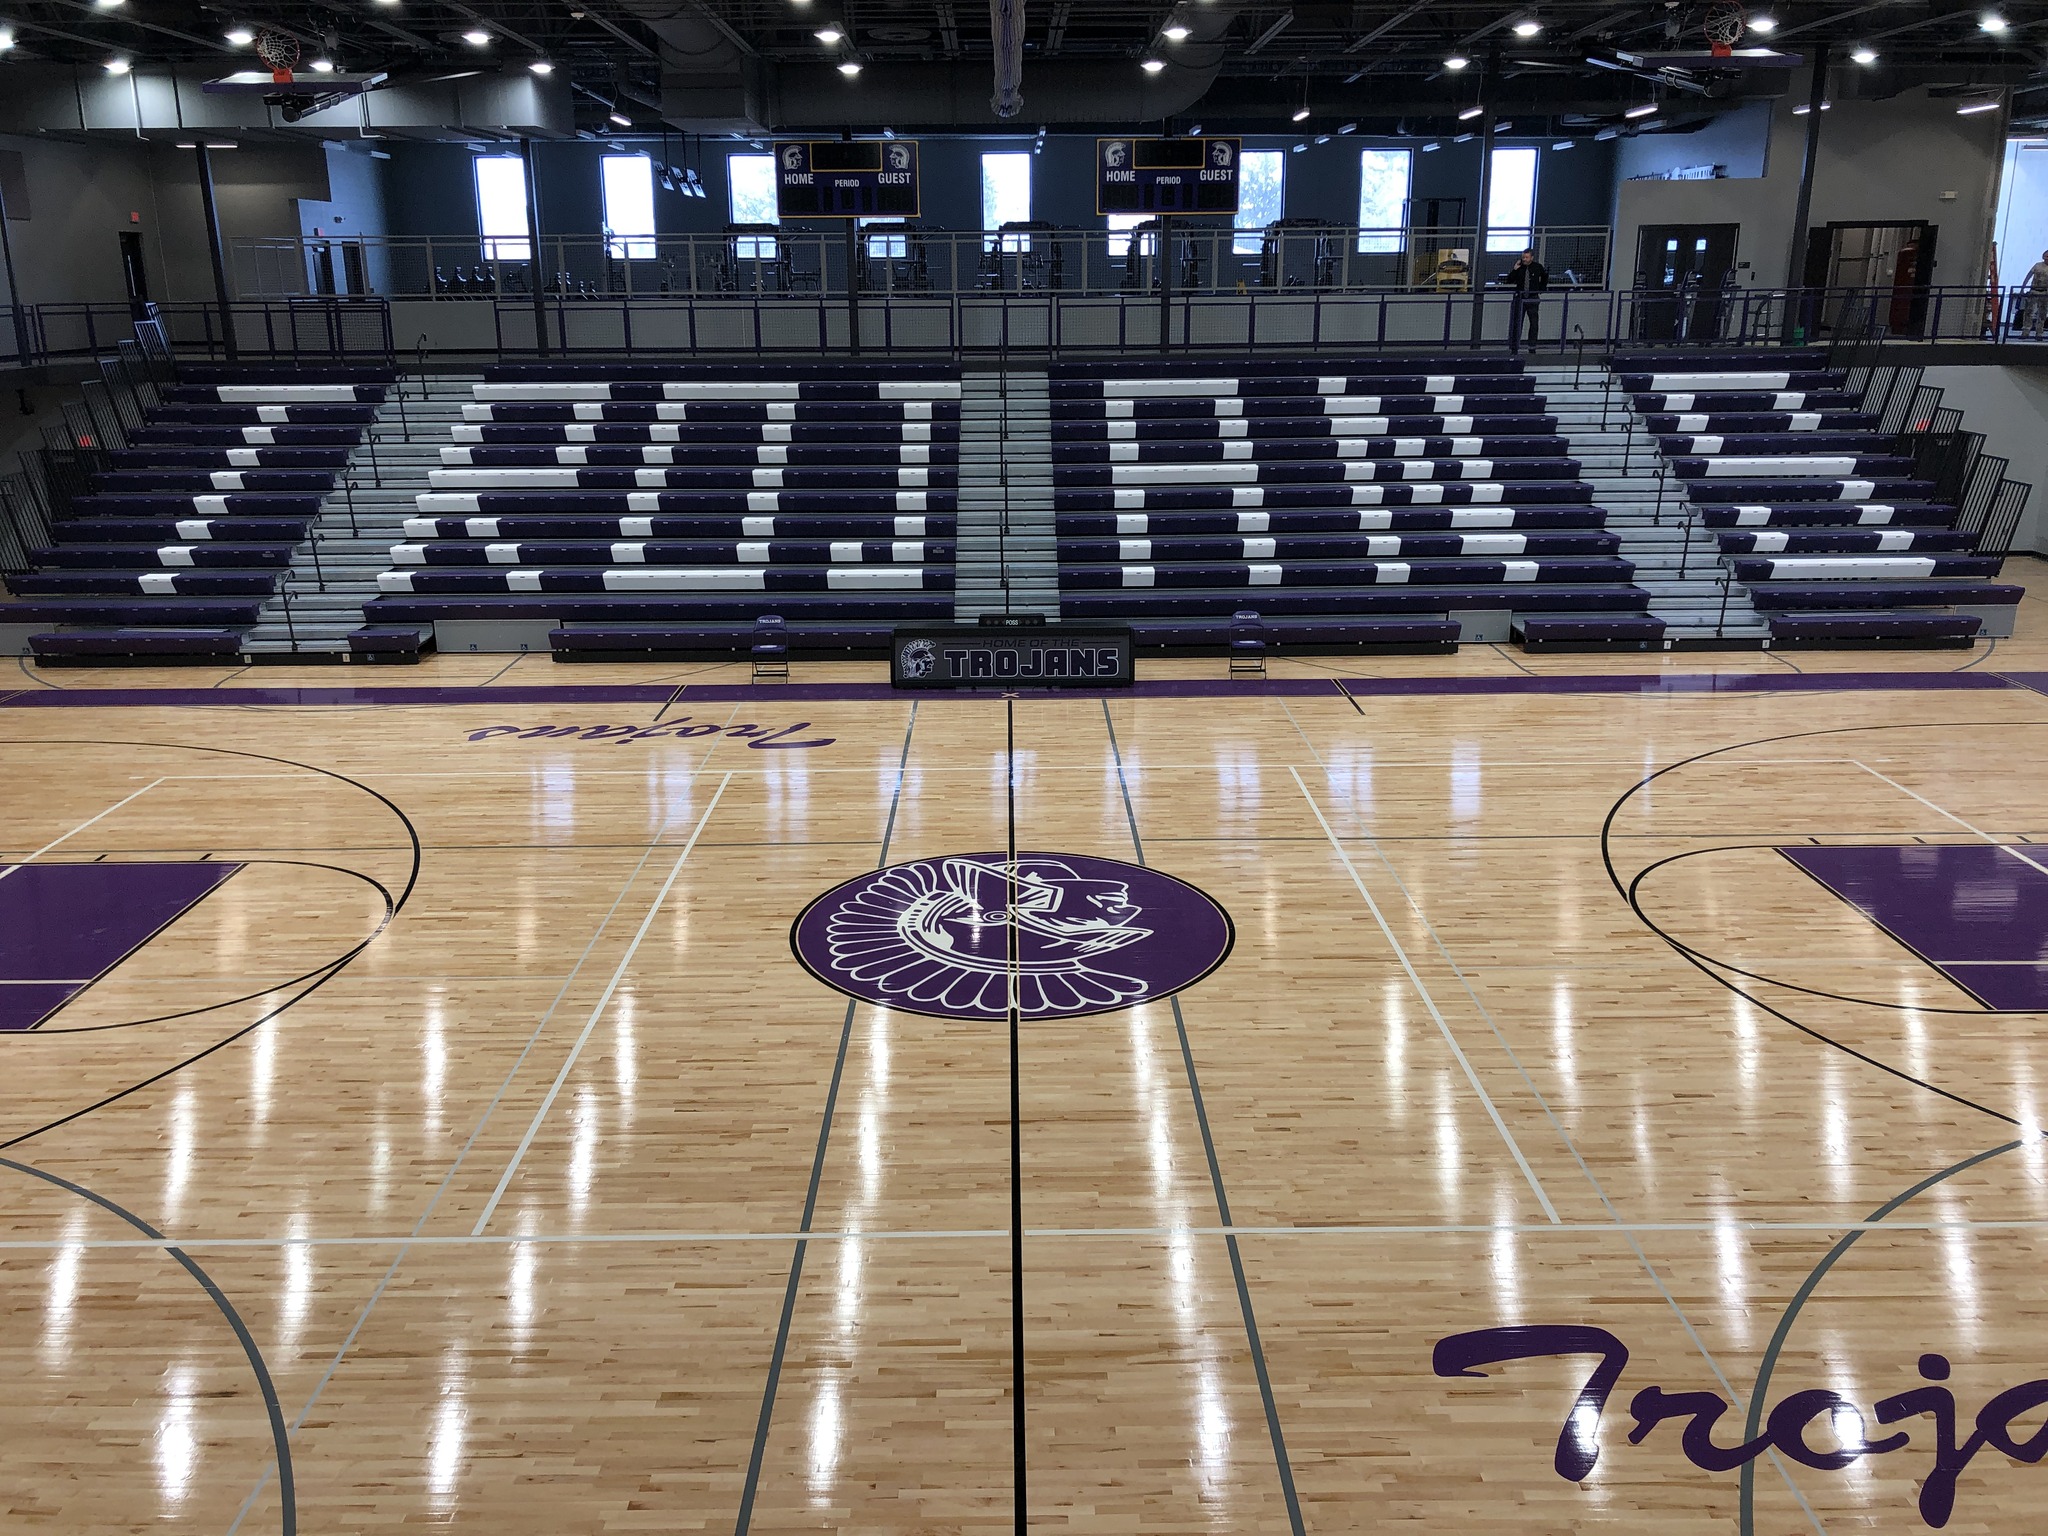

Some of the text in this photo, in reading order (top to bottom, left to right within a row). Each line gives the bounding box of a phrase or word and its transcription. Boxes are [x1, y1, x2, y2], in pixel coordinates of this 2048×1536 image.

[784, 173, 814, 185] HOME
[878, 172, 911, 184] GUEST
[1106, 171, 1136, 182] HOME
[1156, 176, 1181, 185] PERIOD
[1200, 169, 1233, 181] GUEST
[834, 179, 860, 188] PERIOD
[982, 638, 1081, 648] HOME OF THE
[943, 648, 1120, 678] TROJANS
[463, 717, 837, 749] Trojans
